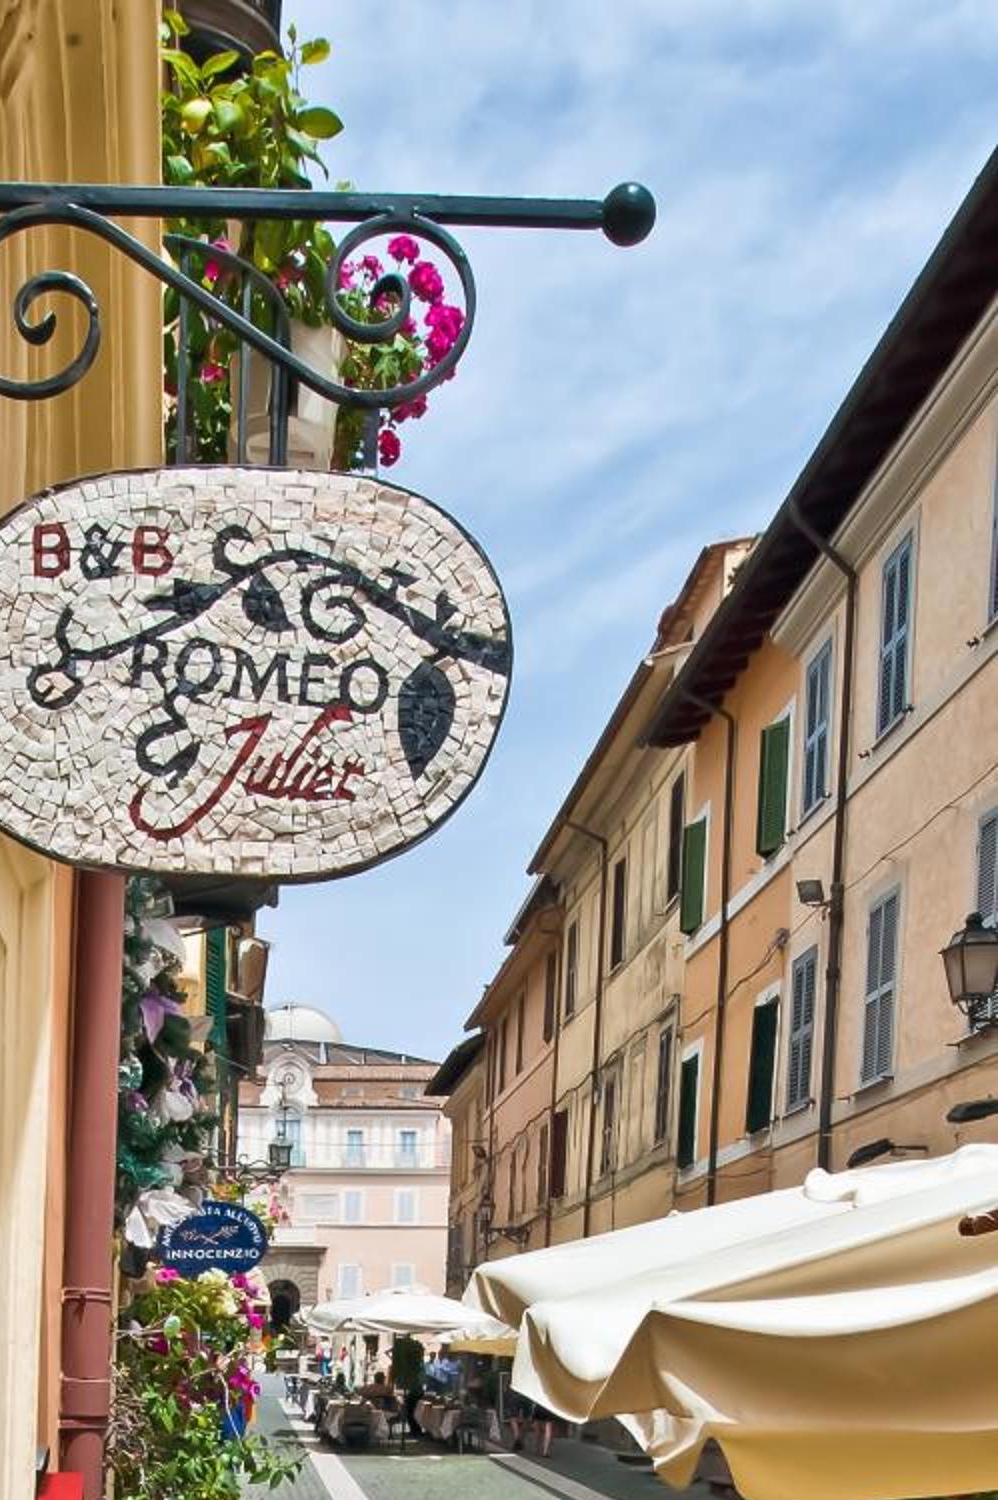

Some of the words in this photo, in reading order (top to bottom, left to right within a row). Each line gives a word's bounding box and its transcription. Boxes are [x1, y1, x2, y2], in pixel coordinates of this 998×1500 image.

[33, 522, 174, 580] B&B
[130, 637, 389, 714] ROMEO
[166, 1247, 260, 1260] INNOCENZIO
